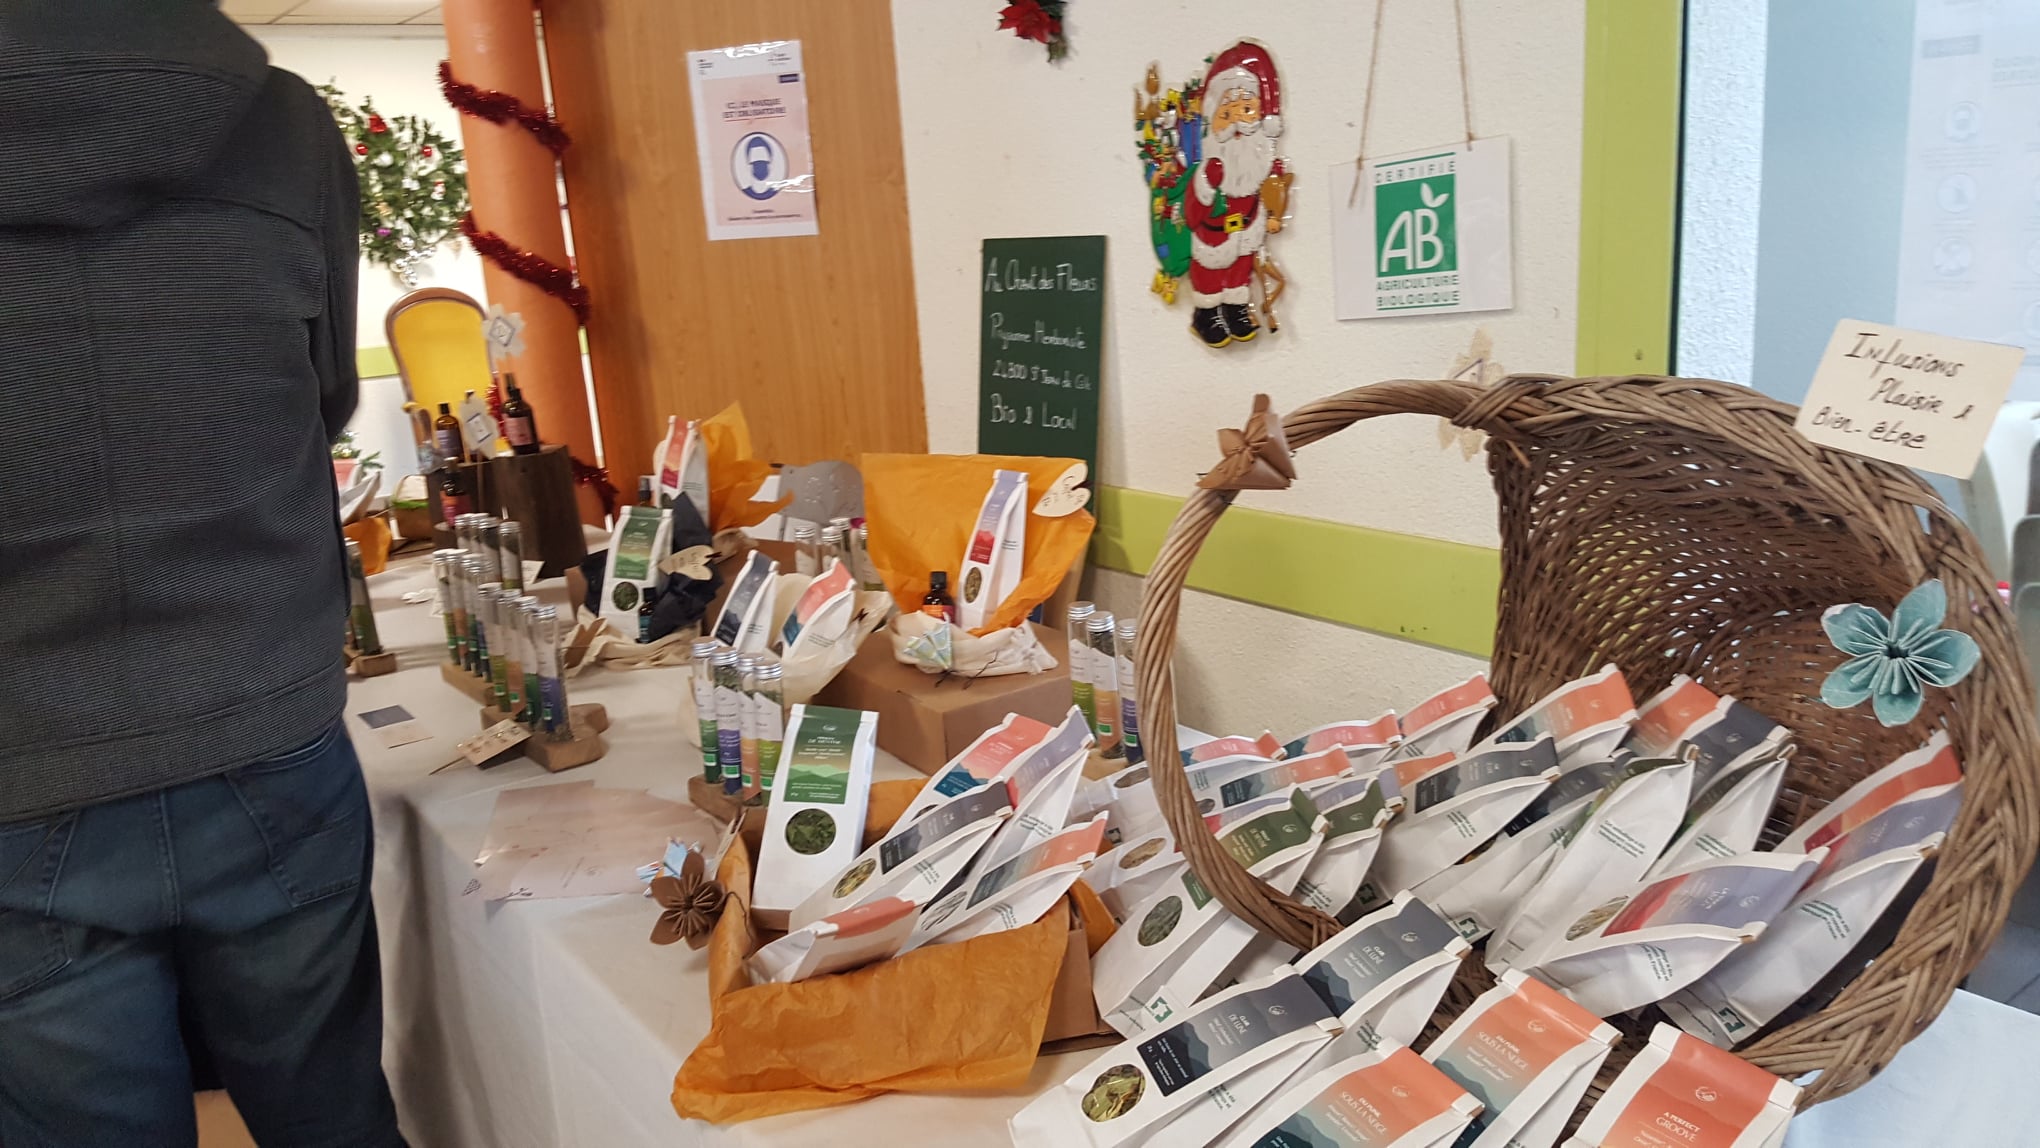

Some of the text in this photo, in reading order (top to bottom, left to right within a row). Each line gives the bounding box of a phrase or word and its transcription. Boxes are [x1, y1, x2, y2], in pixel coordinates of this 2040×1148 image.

[1380, 208, 1444, 273] AB
[1056, 262, 1097, 291] Fleurs
[1376, 274, 1459, 292] AGRICULTURE
[1376, 290, 1460, 307] BIOLOGIQUE
[1844, 332, 1964, 378] Infusions
[1868, 376, 1943, 413] Plaisir
[990, 393, 1017, 424] Bio
[1041, 401, 1078, 431] Local
[1477, 1031, 1496, 1047] SOUS
[1339, 1091, 1358, 1108] SOUS
[1655, 1116, 1698, 1142] GROOVE
[1669, 1114, 1701, 1132] PERFECT
